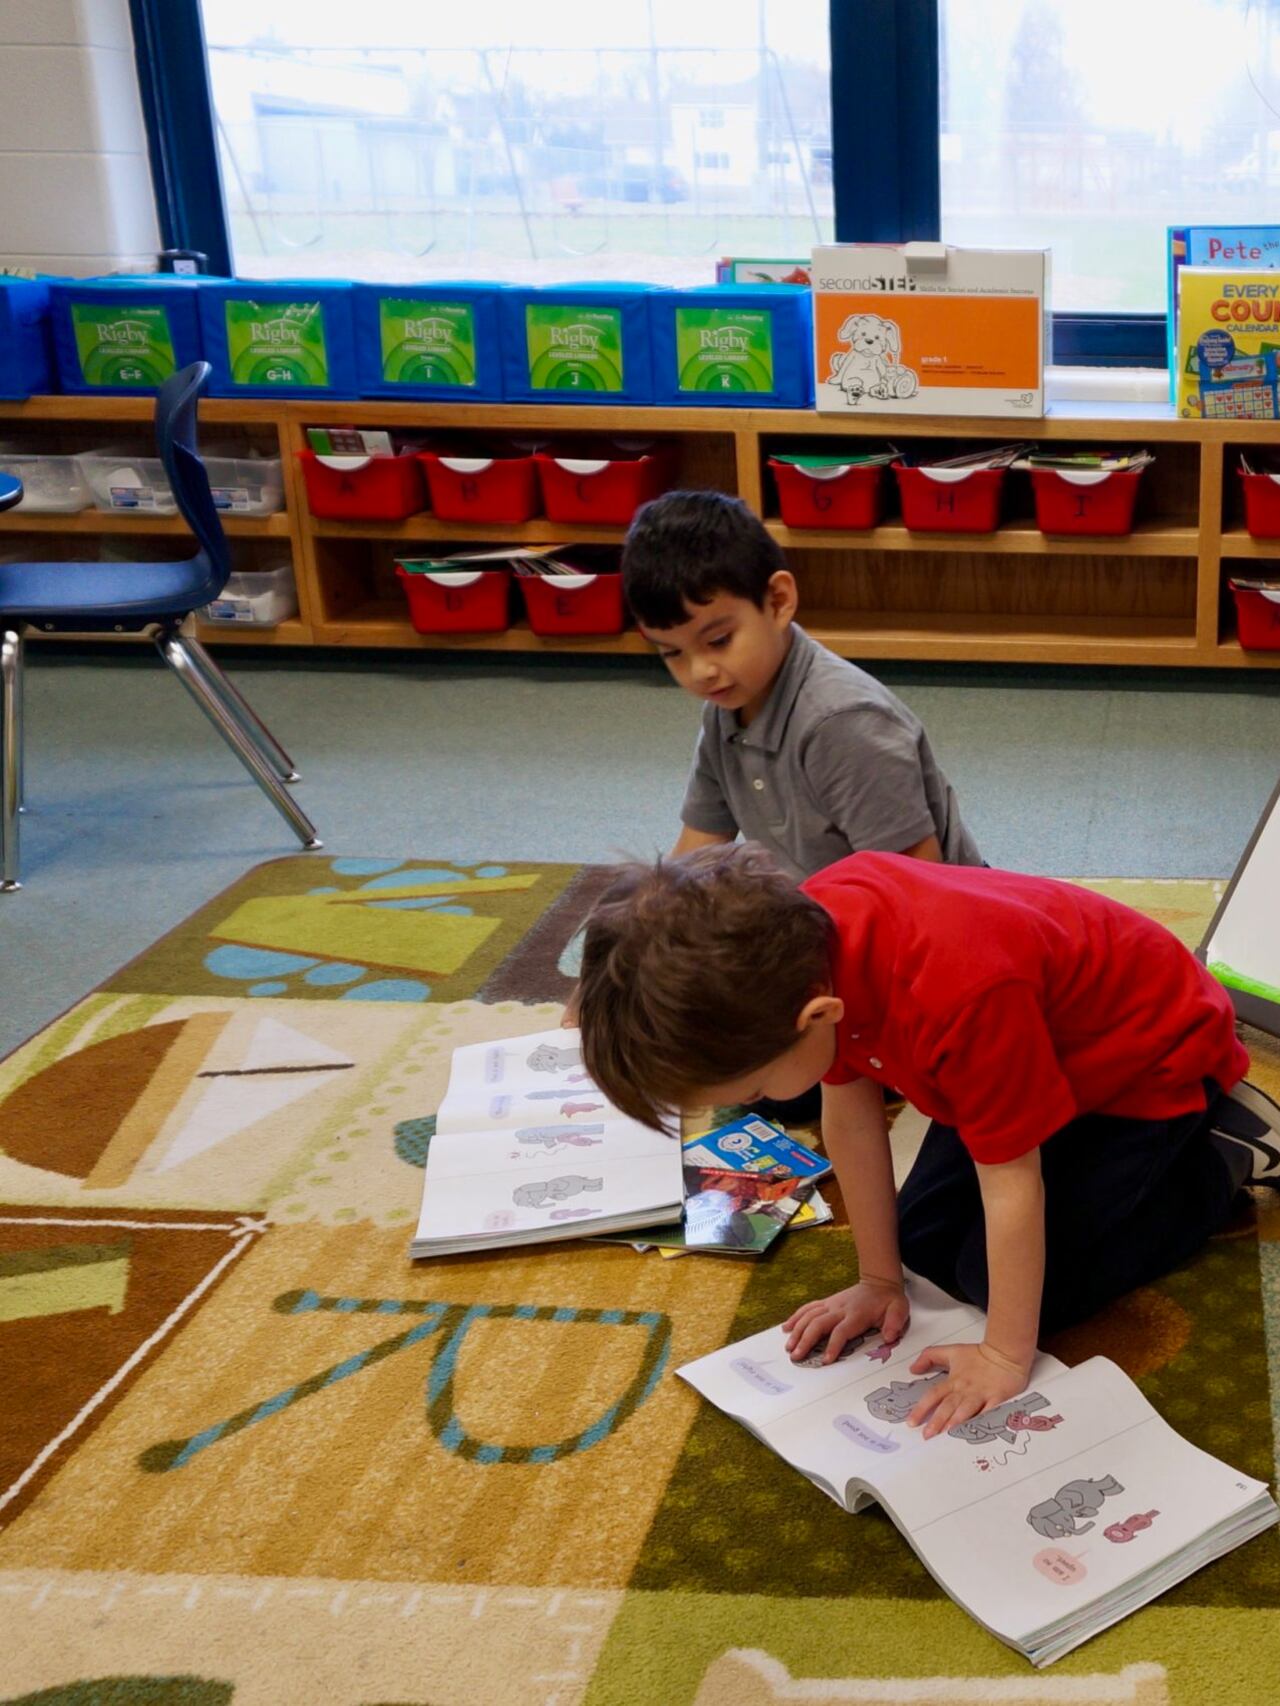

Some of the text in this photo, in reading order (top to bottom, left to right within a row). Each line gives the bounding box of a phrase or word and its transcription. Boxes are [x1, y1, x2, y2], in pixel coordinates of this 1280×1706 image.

[1209, 238, 1262, 260] Pete
[1263, 240, 1280, 251] the
[1223, 284, 1279, 298] EVERY
[97, 322, 148, 344] Rigby
[250, 321, 300, 343] Rigby
[404, 319, 452, 344] Rigby
[550, 327, 599, 350] Rigby
[1226, 323, 1279, 333] CALENDAR
[699, 329, 749, 352] Rigby
[339, 476, 356, 495] A
[461, 479, 479, 501] B
[812, 481, 834, 512] G
[935, 490, 956, 515] H
[555, 594, 576, 616] E
